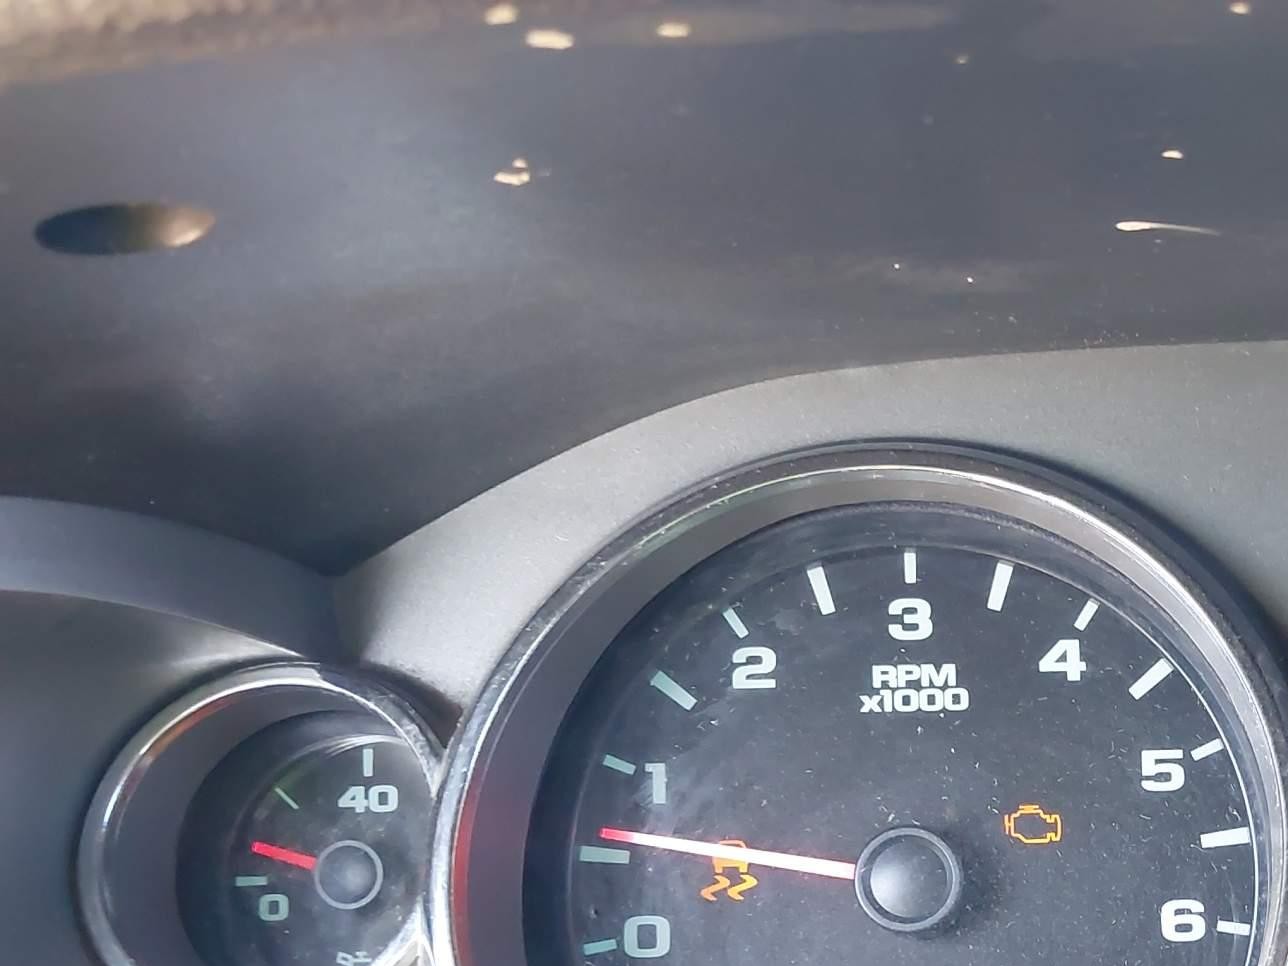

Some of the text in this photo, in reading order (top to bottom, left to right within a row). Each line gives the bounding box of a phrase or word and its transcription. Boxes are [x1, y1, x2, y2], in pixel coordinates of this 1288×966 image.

[887, 598, 934, 641] 3
[731, 646, 777, 690] 2
[871, 664, 957, 688] RPM
[1037, 639, 1087, 682] 4
[859, 687, 970, 713] x1000
[643, 762, 668, 804] 1
[1140, 749, 1186, 792] 5
[337, 785, 399, 813] 40
[258, 894, 289, 921] 0
[1160, 899, 1206, 942] 6
[623, 915, 671, 957] 0
